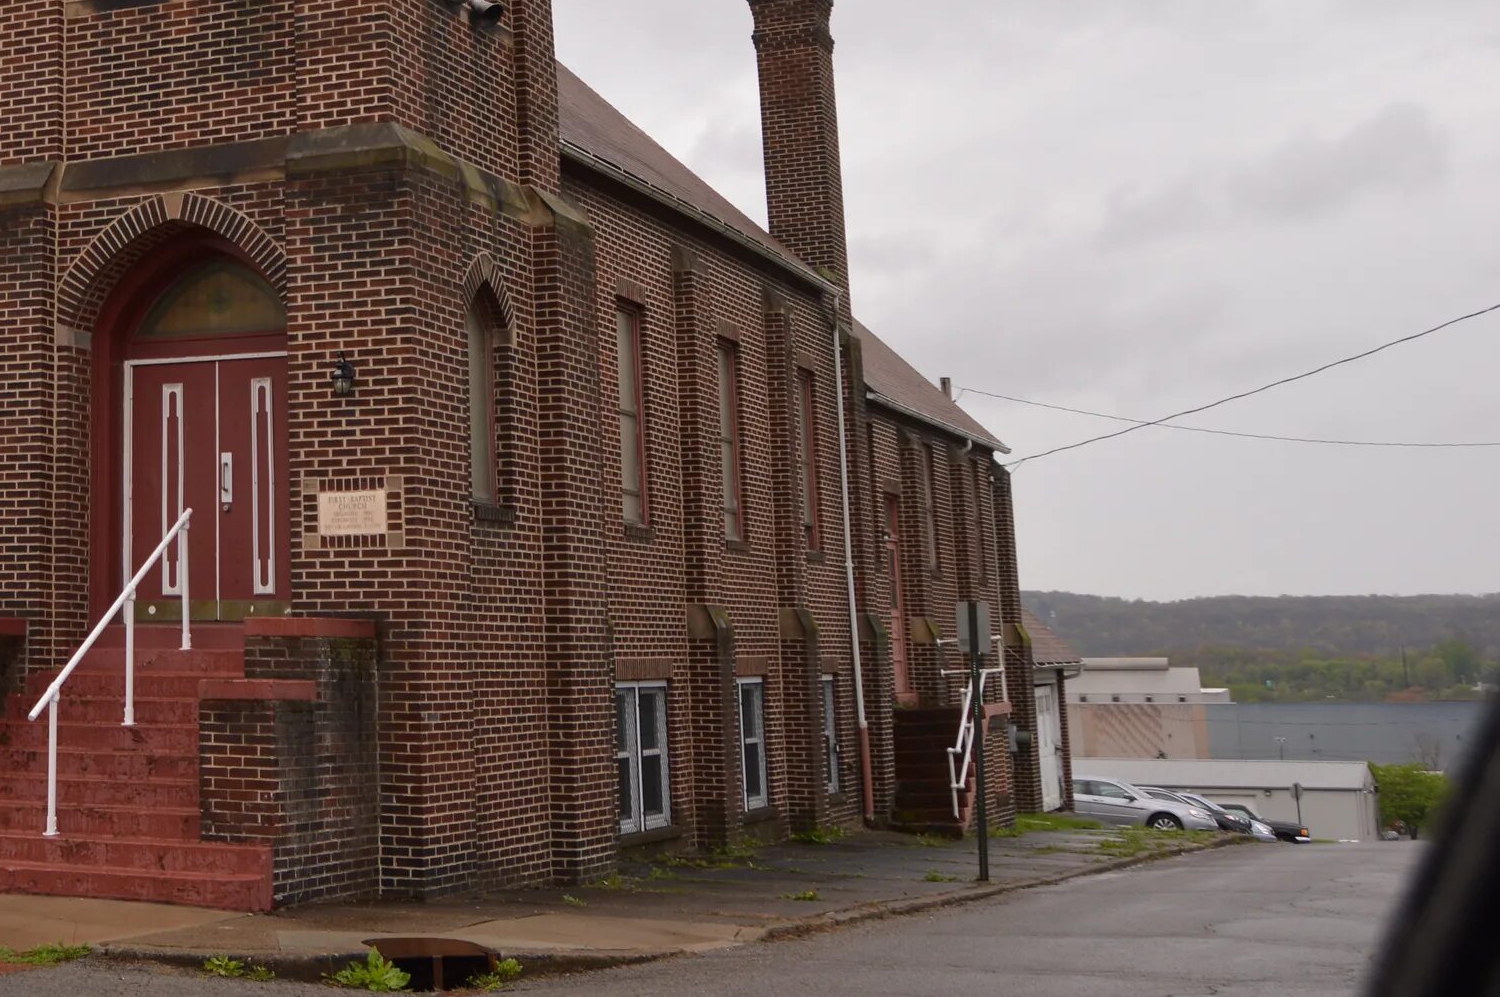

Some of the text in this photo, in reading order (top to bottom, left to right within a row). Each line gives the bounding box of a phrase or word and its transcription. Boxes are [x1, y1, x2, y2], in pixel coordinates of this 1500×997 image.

[328, 495, 376, 504] FIRST BAPTIST
[338, 502, 367, 510] CHURCH
